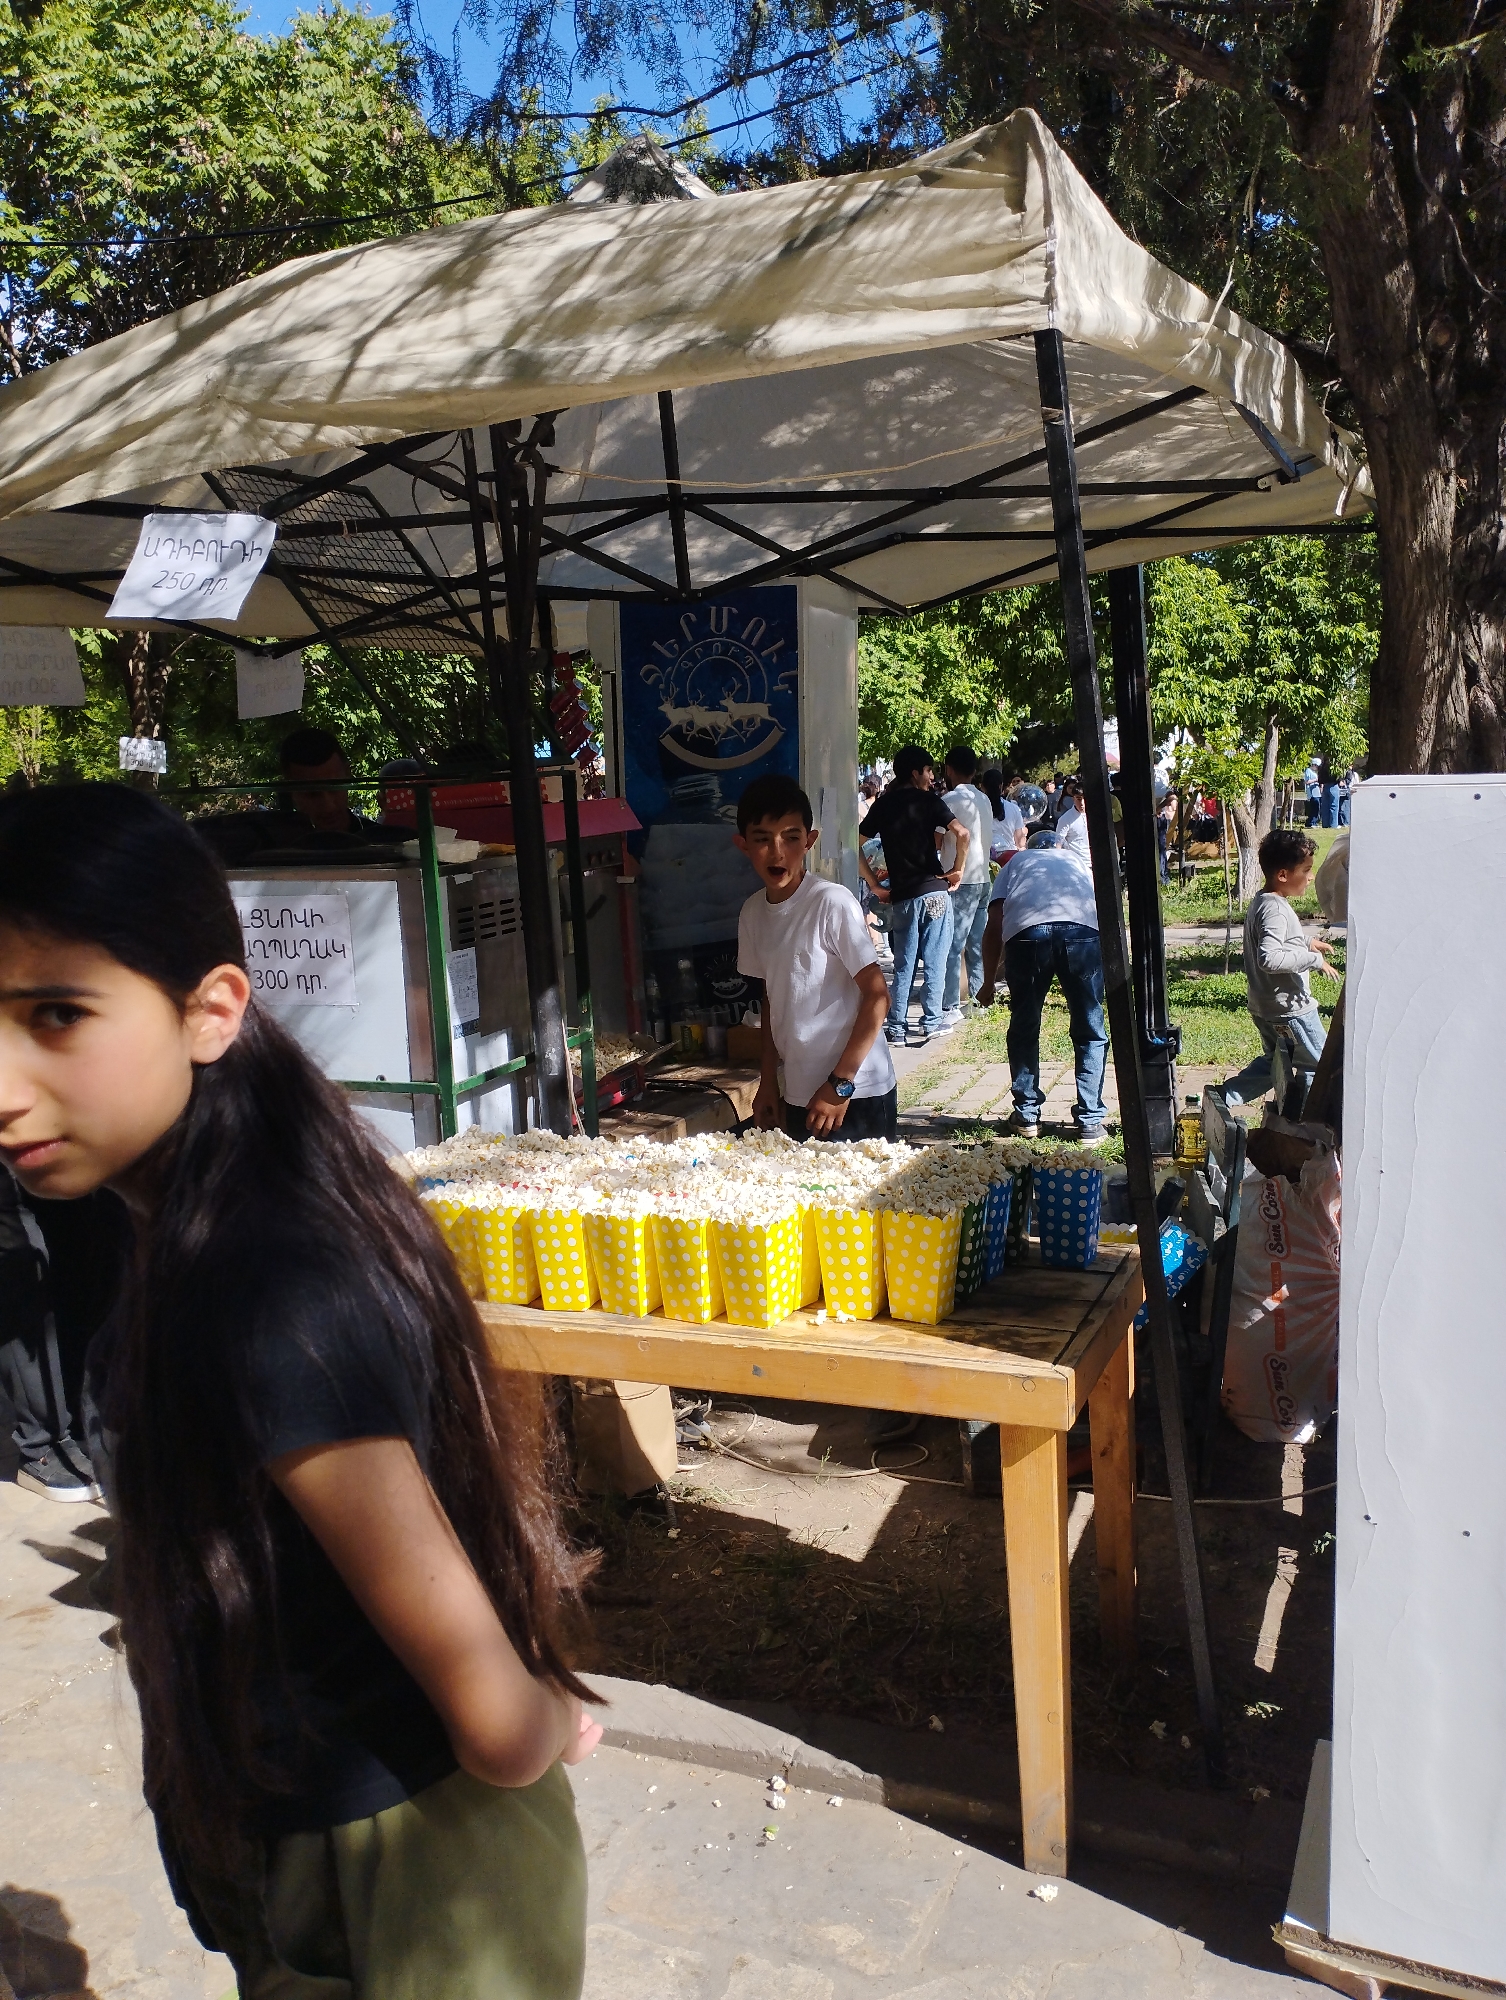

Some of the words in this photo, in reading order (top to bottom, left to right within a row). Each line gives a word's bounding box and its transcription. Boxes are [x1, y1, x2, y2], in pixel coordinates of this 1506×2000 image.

[143, 536, 263, 563] ԱԴԻԲՈՒԴԻ
[152, 570, 196, 591] 250
[198, 577, 228, 596] դր.
[639, 606, 798, 692] ՋԵՐՄՈՒԿ
[680, 641, 754, 670] ԳՐՈՒՊ
[252, 969, 289, 990] 300
[296, 974, 328, 995] դր.
[1262, 1182, 1281, 1220] Corn
[1268, 1223, 1285, 1254] Sun
[1269, 1358, 1288, 1392] Sun
